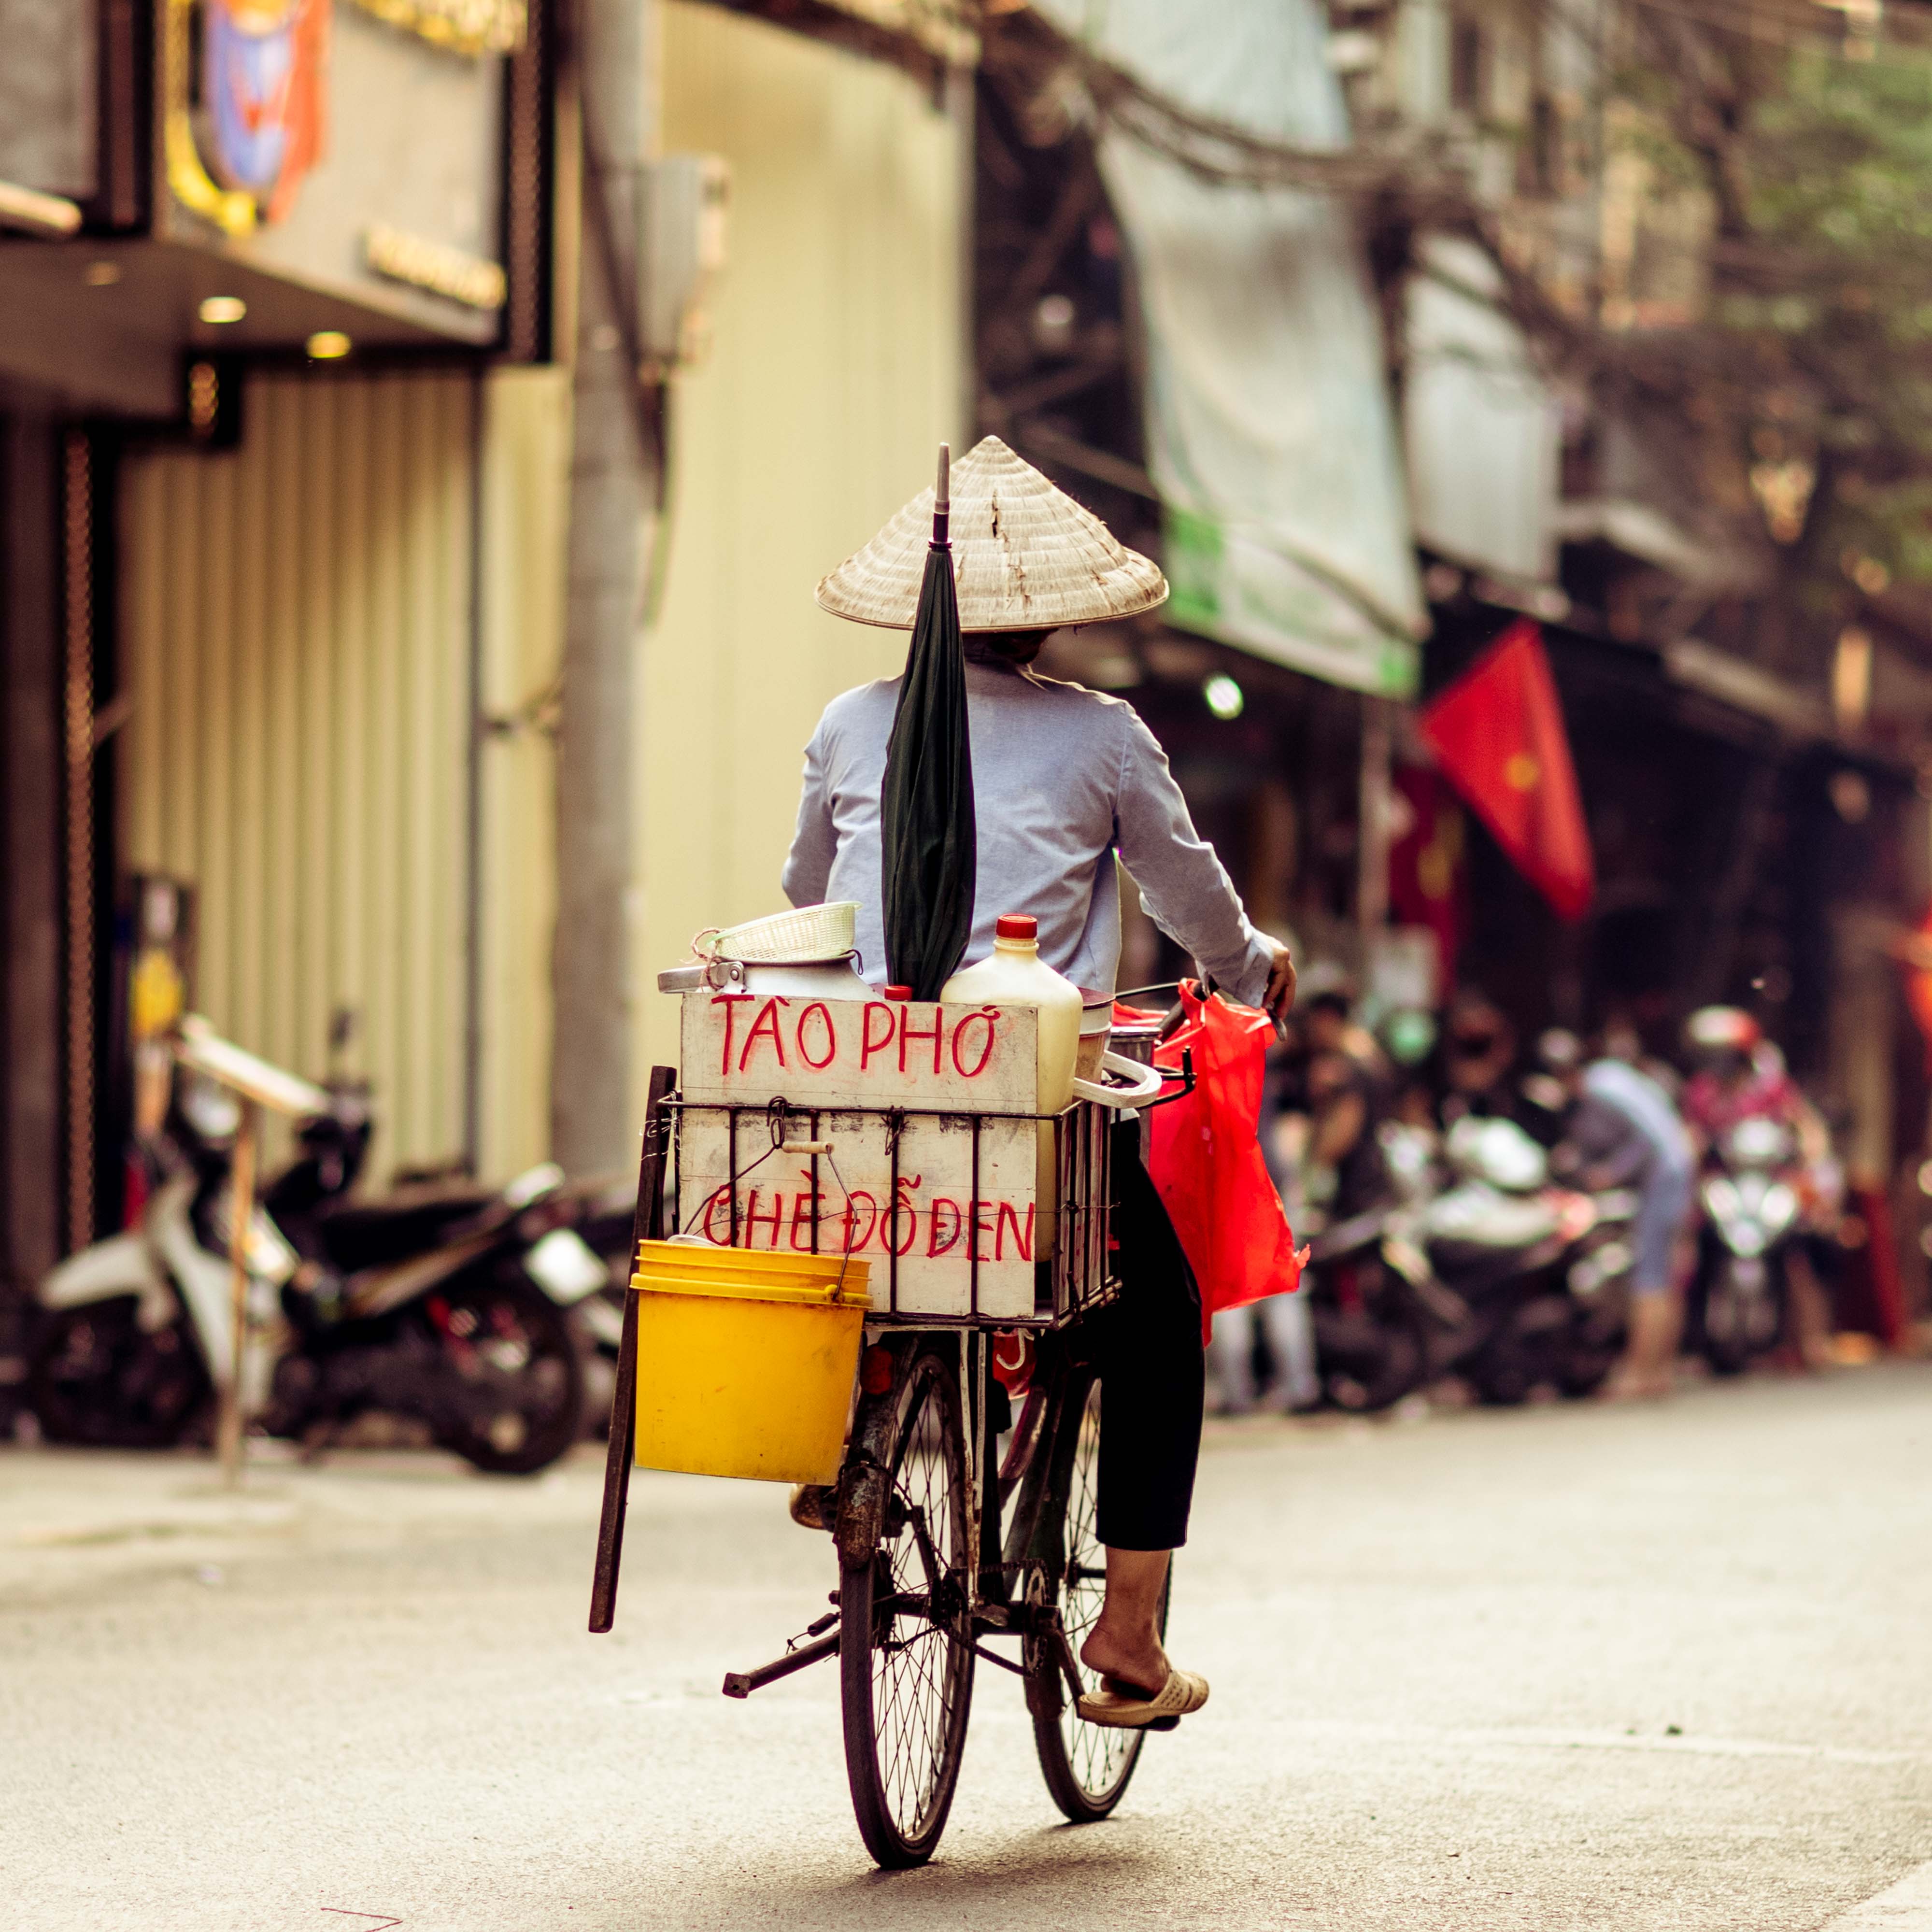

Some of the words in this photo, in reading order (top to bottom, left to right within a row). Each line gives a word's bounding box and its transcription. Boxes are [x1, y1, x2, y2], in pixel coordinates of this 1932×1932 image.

[711, 994, 837, 1076] TÀO
[860, 1001, 1001, 1078] PHỚ
[703, 1169, 826, 1253] CHÈ
[842, 1174, 922, 1257] ĐỖ
[926, 1197, 1036, 1262] ĐEN
